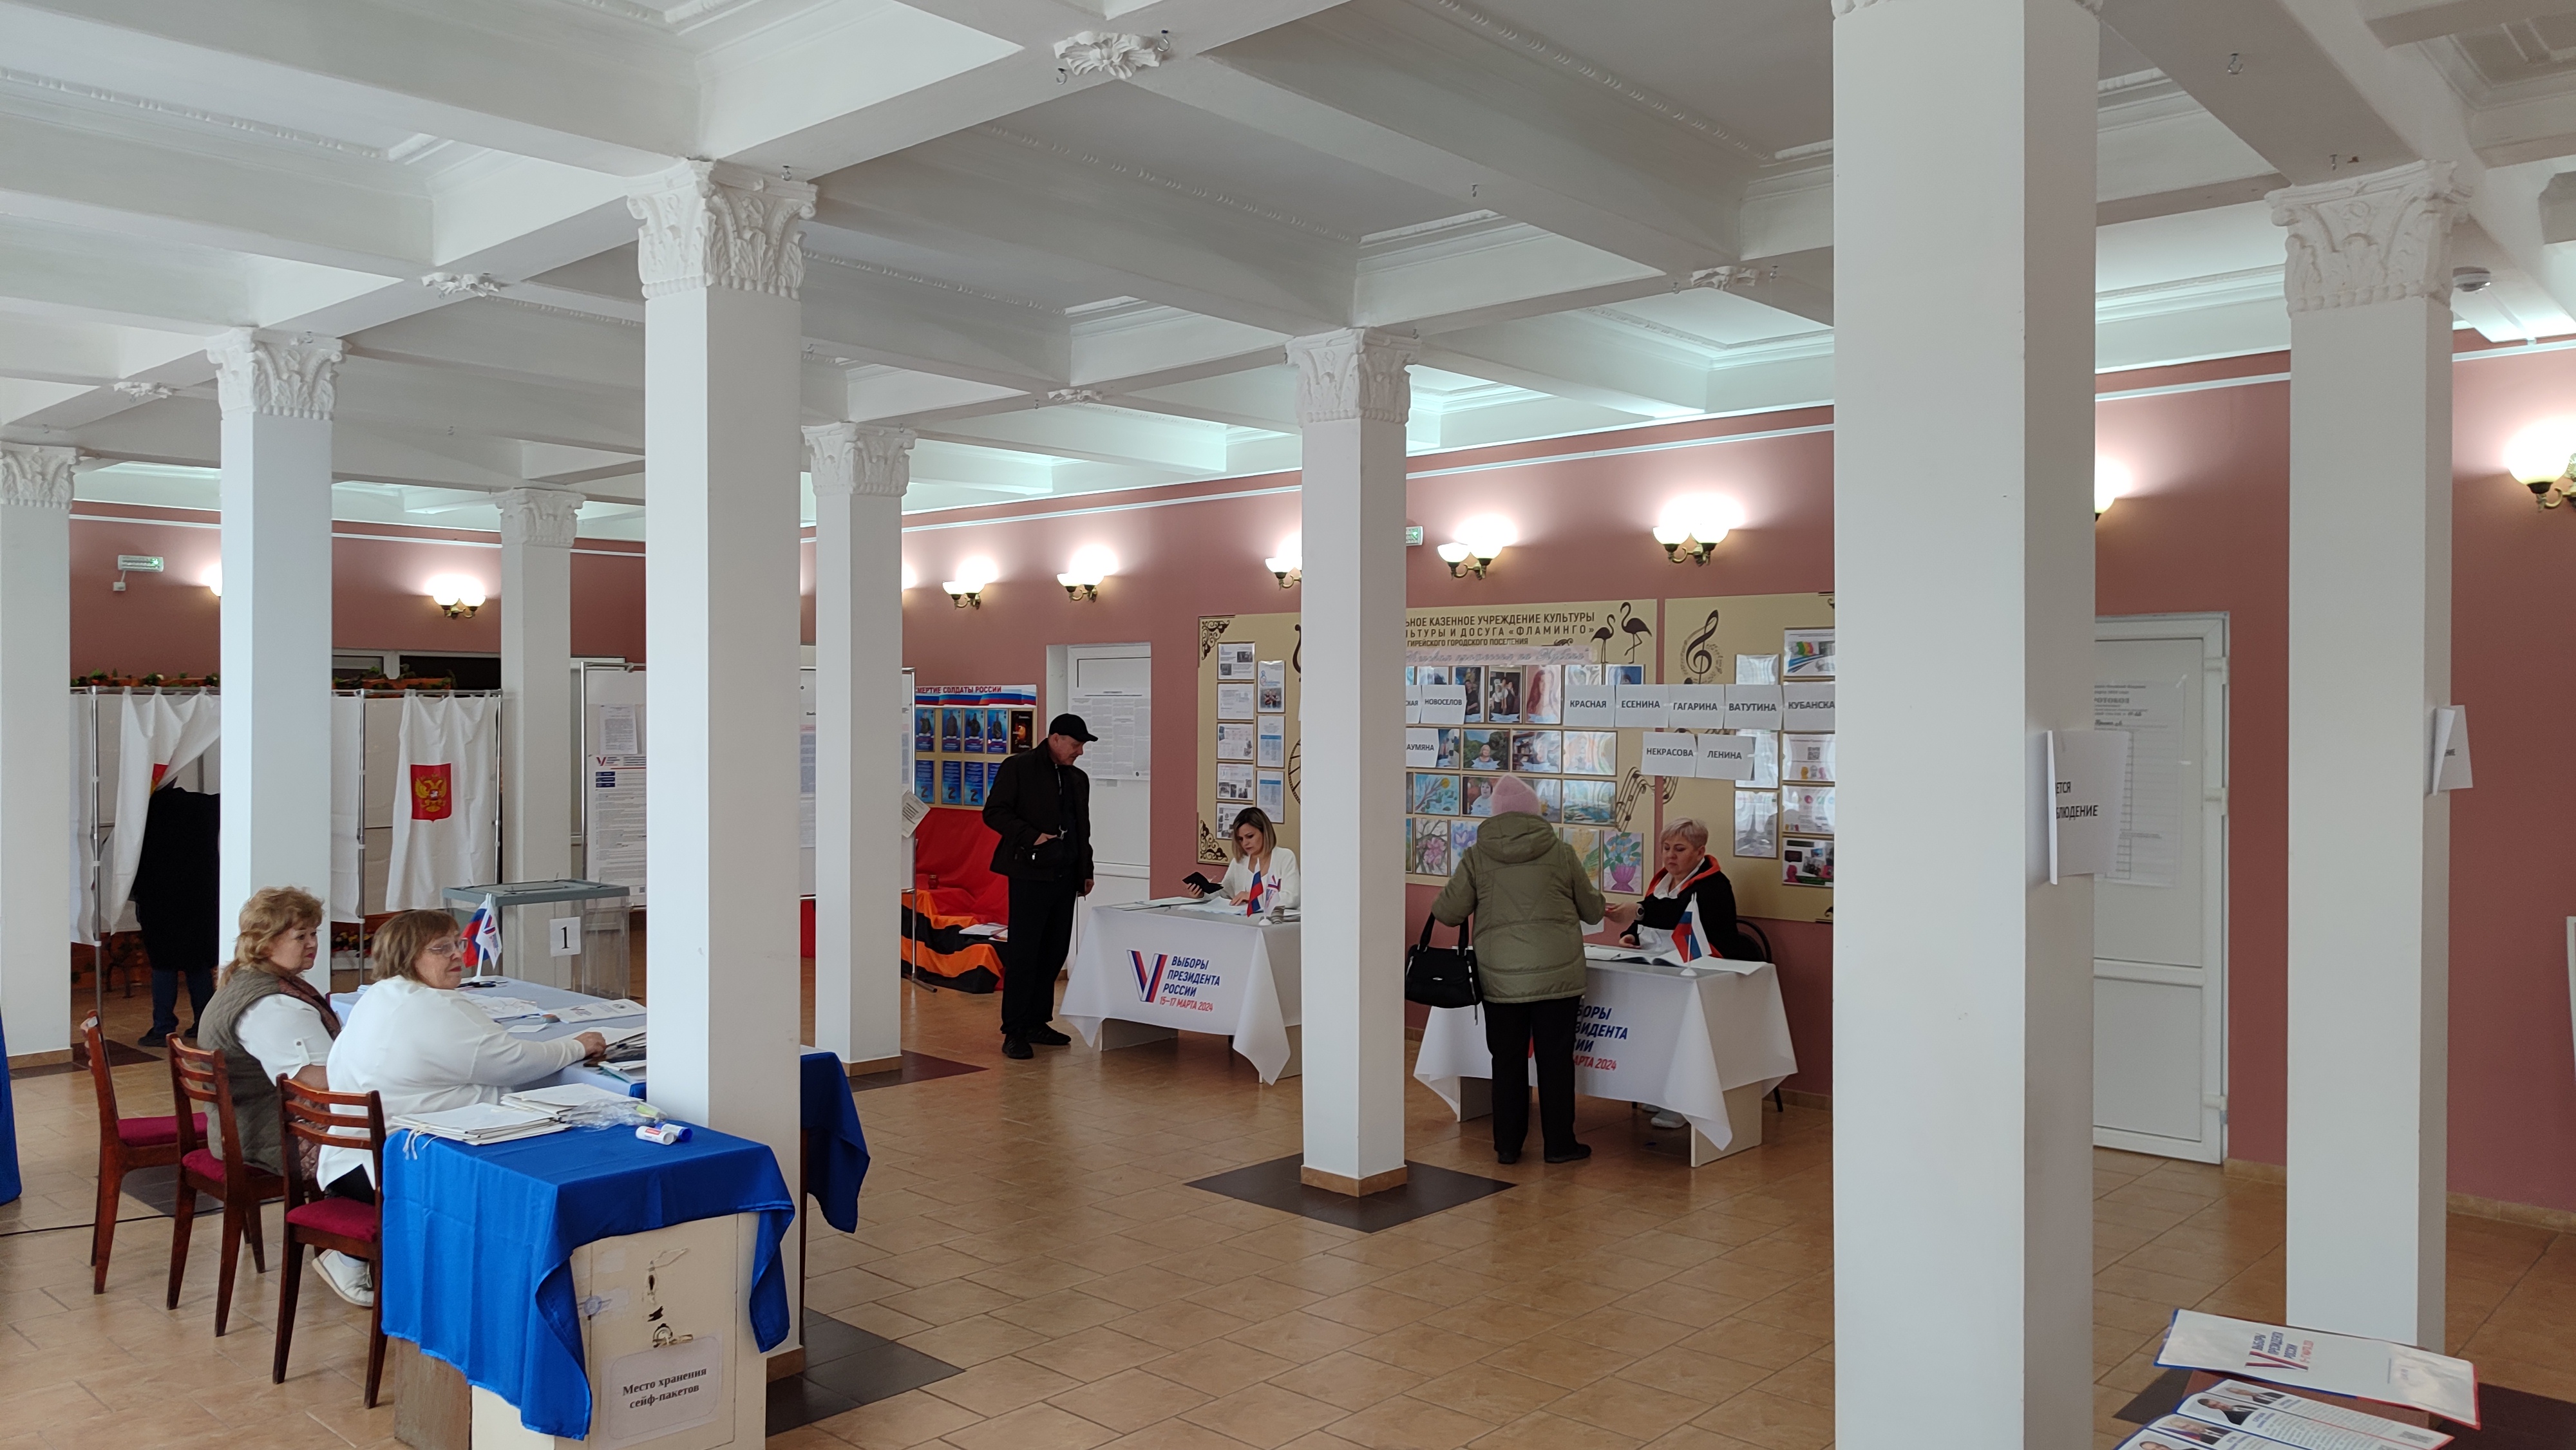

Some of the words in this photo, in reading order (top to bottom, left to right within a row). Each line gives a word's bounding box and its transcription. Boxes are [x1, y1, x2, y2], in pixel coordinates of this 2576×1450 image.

[1429, 616, 1475, 626] КАЗЕННОЕ
[1477, 614, 1540, 625] УЧРЕЖДЕНИЕ
[1544, 612, 1595, 623] КУЛЬТУРЫ
[1450, 628, 1456, 637] И
[1460, 626, 1504, 638] ДОСУГА
[1407, 639, 1446, 647] ГИРЕЙСКОГО
[1447, 638, 1488, 646] ГОРОДСКОГО
[943, 686, 974, 695] СОЛДАТЫ
[1569, 700, 1607, 708] КРАСНАЯ
[1621, 700, 1661, 708] ЕСЕНИНА
[1673, 702, 1718, 711] ГАГАРИНА
[1728, 703, 1777, 711] ВАТУТИНА
[1788, 701, 1835, 710] КУБАНСКА
[1646, 748, 1694, 757] НЕКРАСОВА
[1707, 750, 1743, 760] ЛЕНИНА
[561, 926, 570, 950] 1
[1171, 956, 1209, 970] ВЫБОРЫ
[1167, 970, 1220, 986] ПРЕЗИДЕНТА
[1162, 983, 1197, 997] РОССИИ
[1177, 999, 1197, 1010] МАРТА
[1198, 1001, 1213, 1012] 2024
[1595, 1058, 1617, 1071] 2024
[623, 1381, 656, 1396] Место
[658, 1368, 707, 1388] хранения
[629, 1385, 699, 1409] сейф-пакетов
